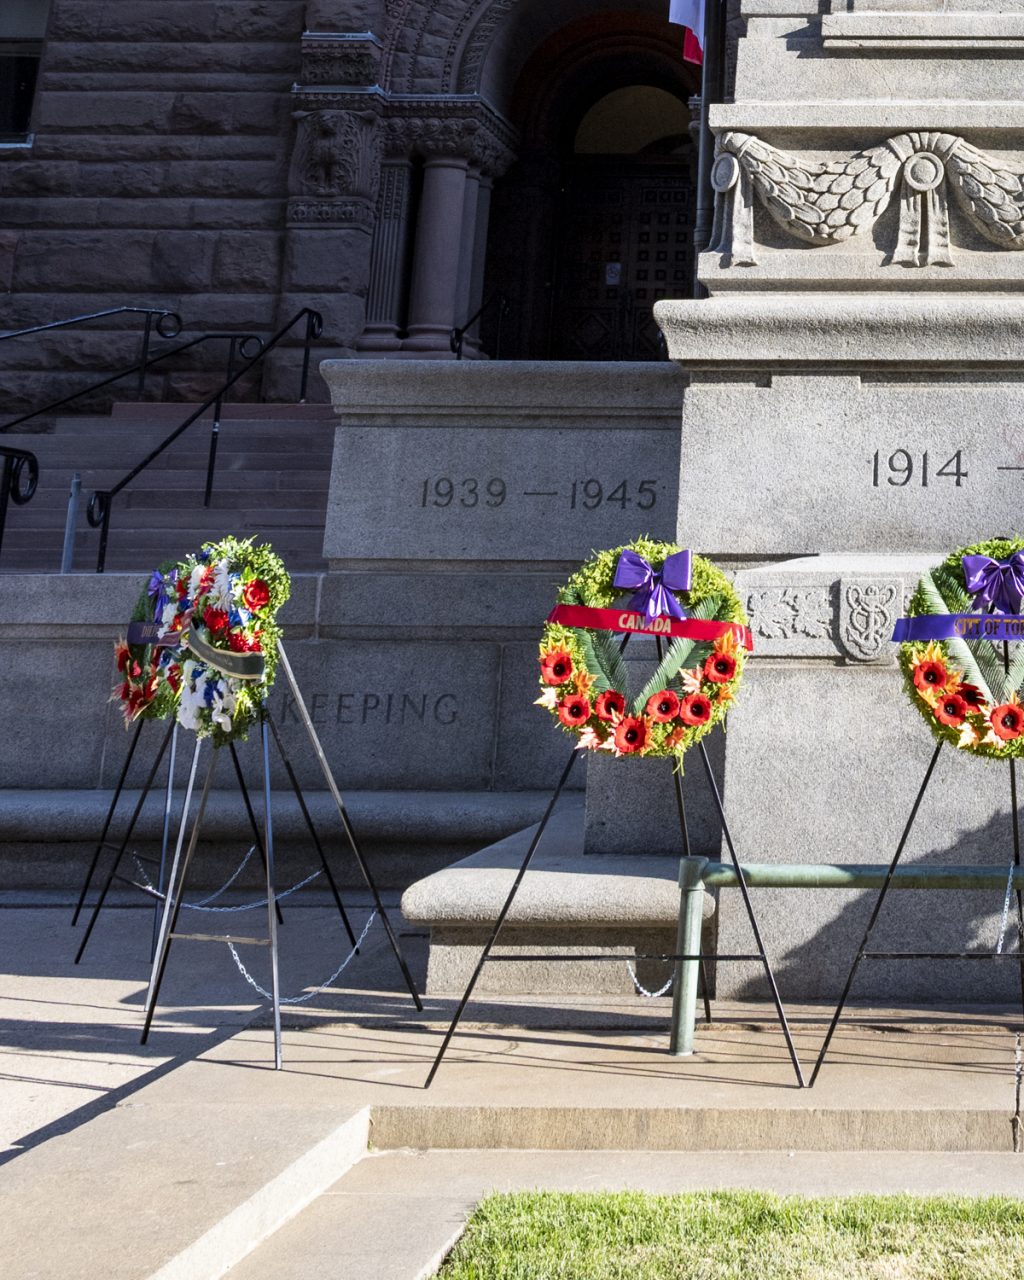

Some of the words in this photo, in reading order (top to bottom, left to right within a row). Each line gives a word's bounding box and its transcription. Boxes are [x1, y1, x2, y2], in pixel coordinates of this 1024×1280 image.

[872, 448, 968, 487] 1914
[421, 477, 507, 508] 1939
[569, 478, 657, 510] 1945
[618, 613, 672, 634] CANADA
[954, 618, 981, 635] CITY
[984, 618, 1000, 635] OF
[280, 693, 458, 725] KEEPING
